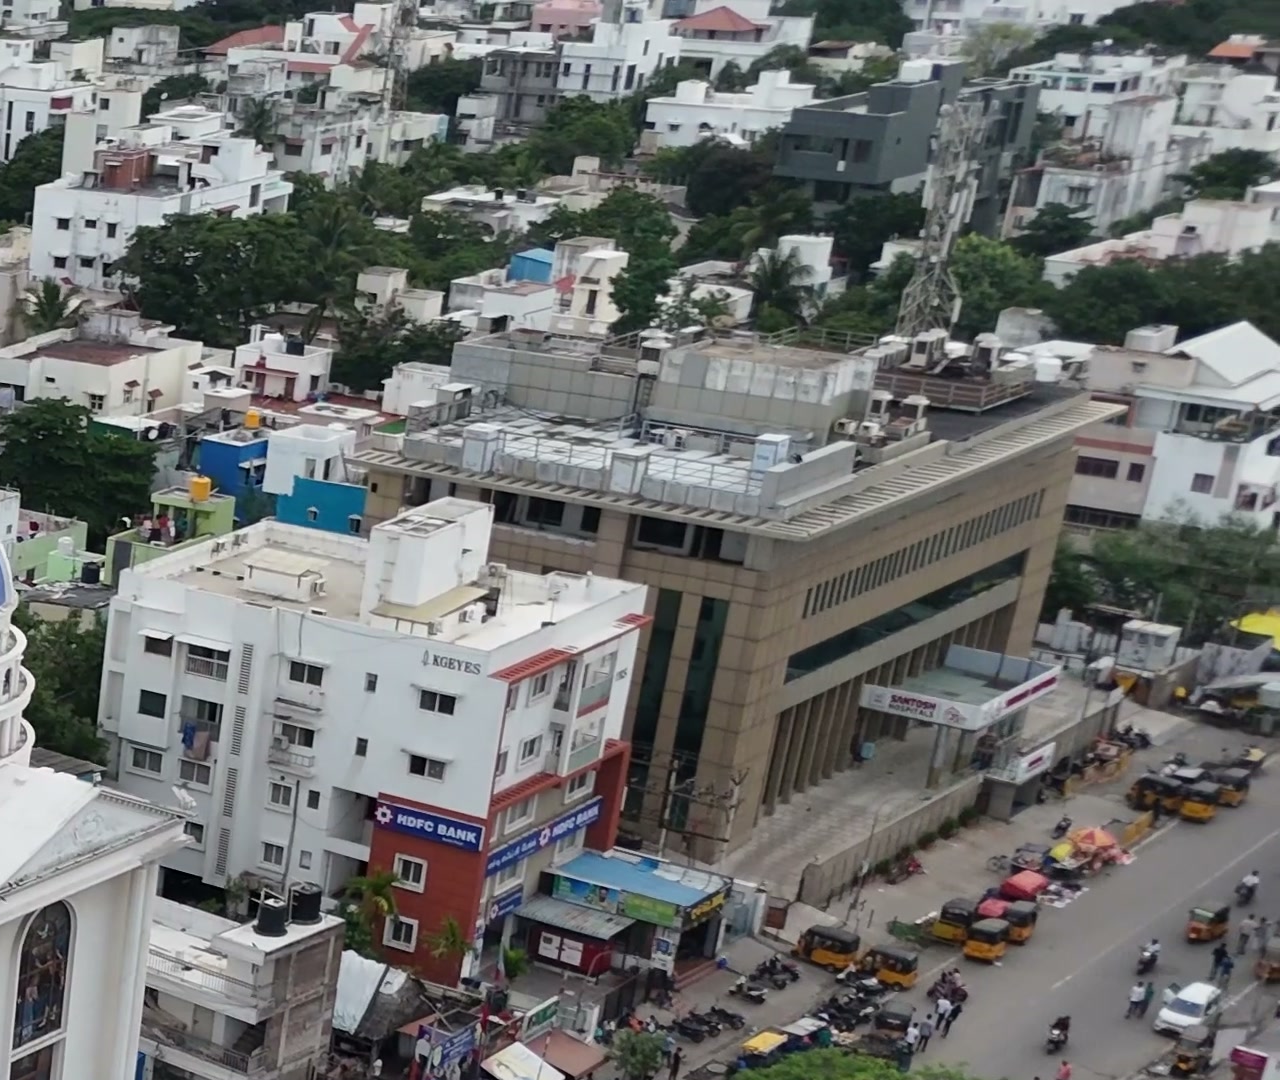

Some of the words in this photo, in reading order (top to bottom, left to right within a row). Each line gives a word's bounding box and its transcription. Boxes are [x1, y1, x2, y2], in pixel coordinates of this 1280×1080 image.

[432, 654, 481, 675] KGEYES
[888, 703, 934, 718] HOSPITALS
[890, 694, 937, 711] SANTOSH
[396, 813, 435, 832] HDFC
[437, 823, 477, 844] BANK
[552, 816, 576, 837] HDFC
[576, 804, 599, 825] BANK
